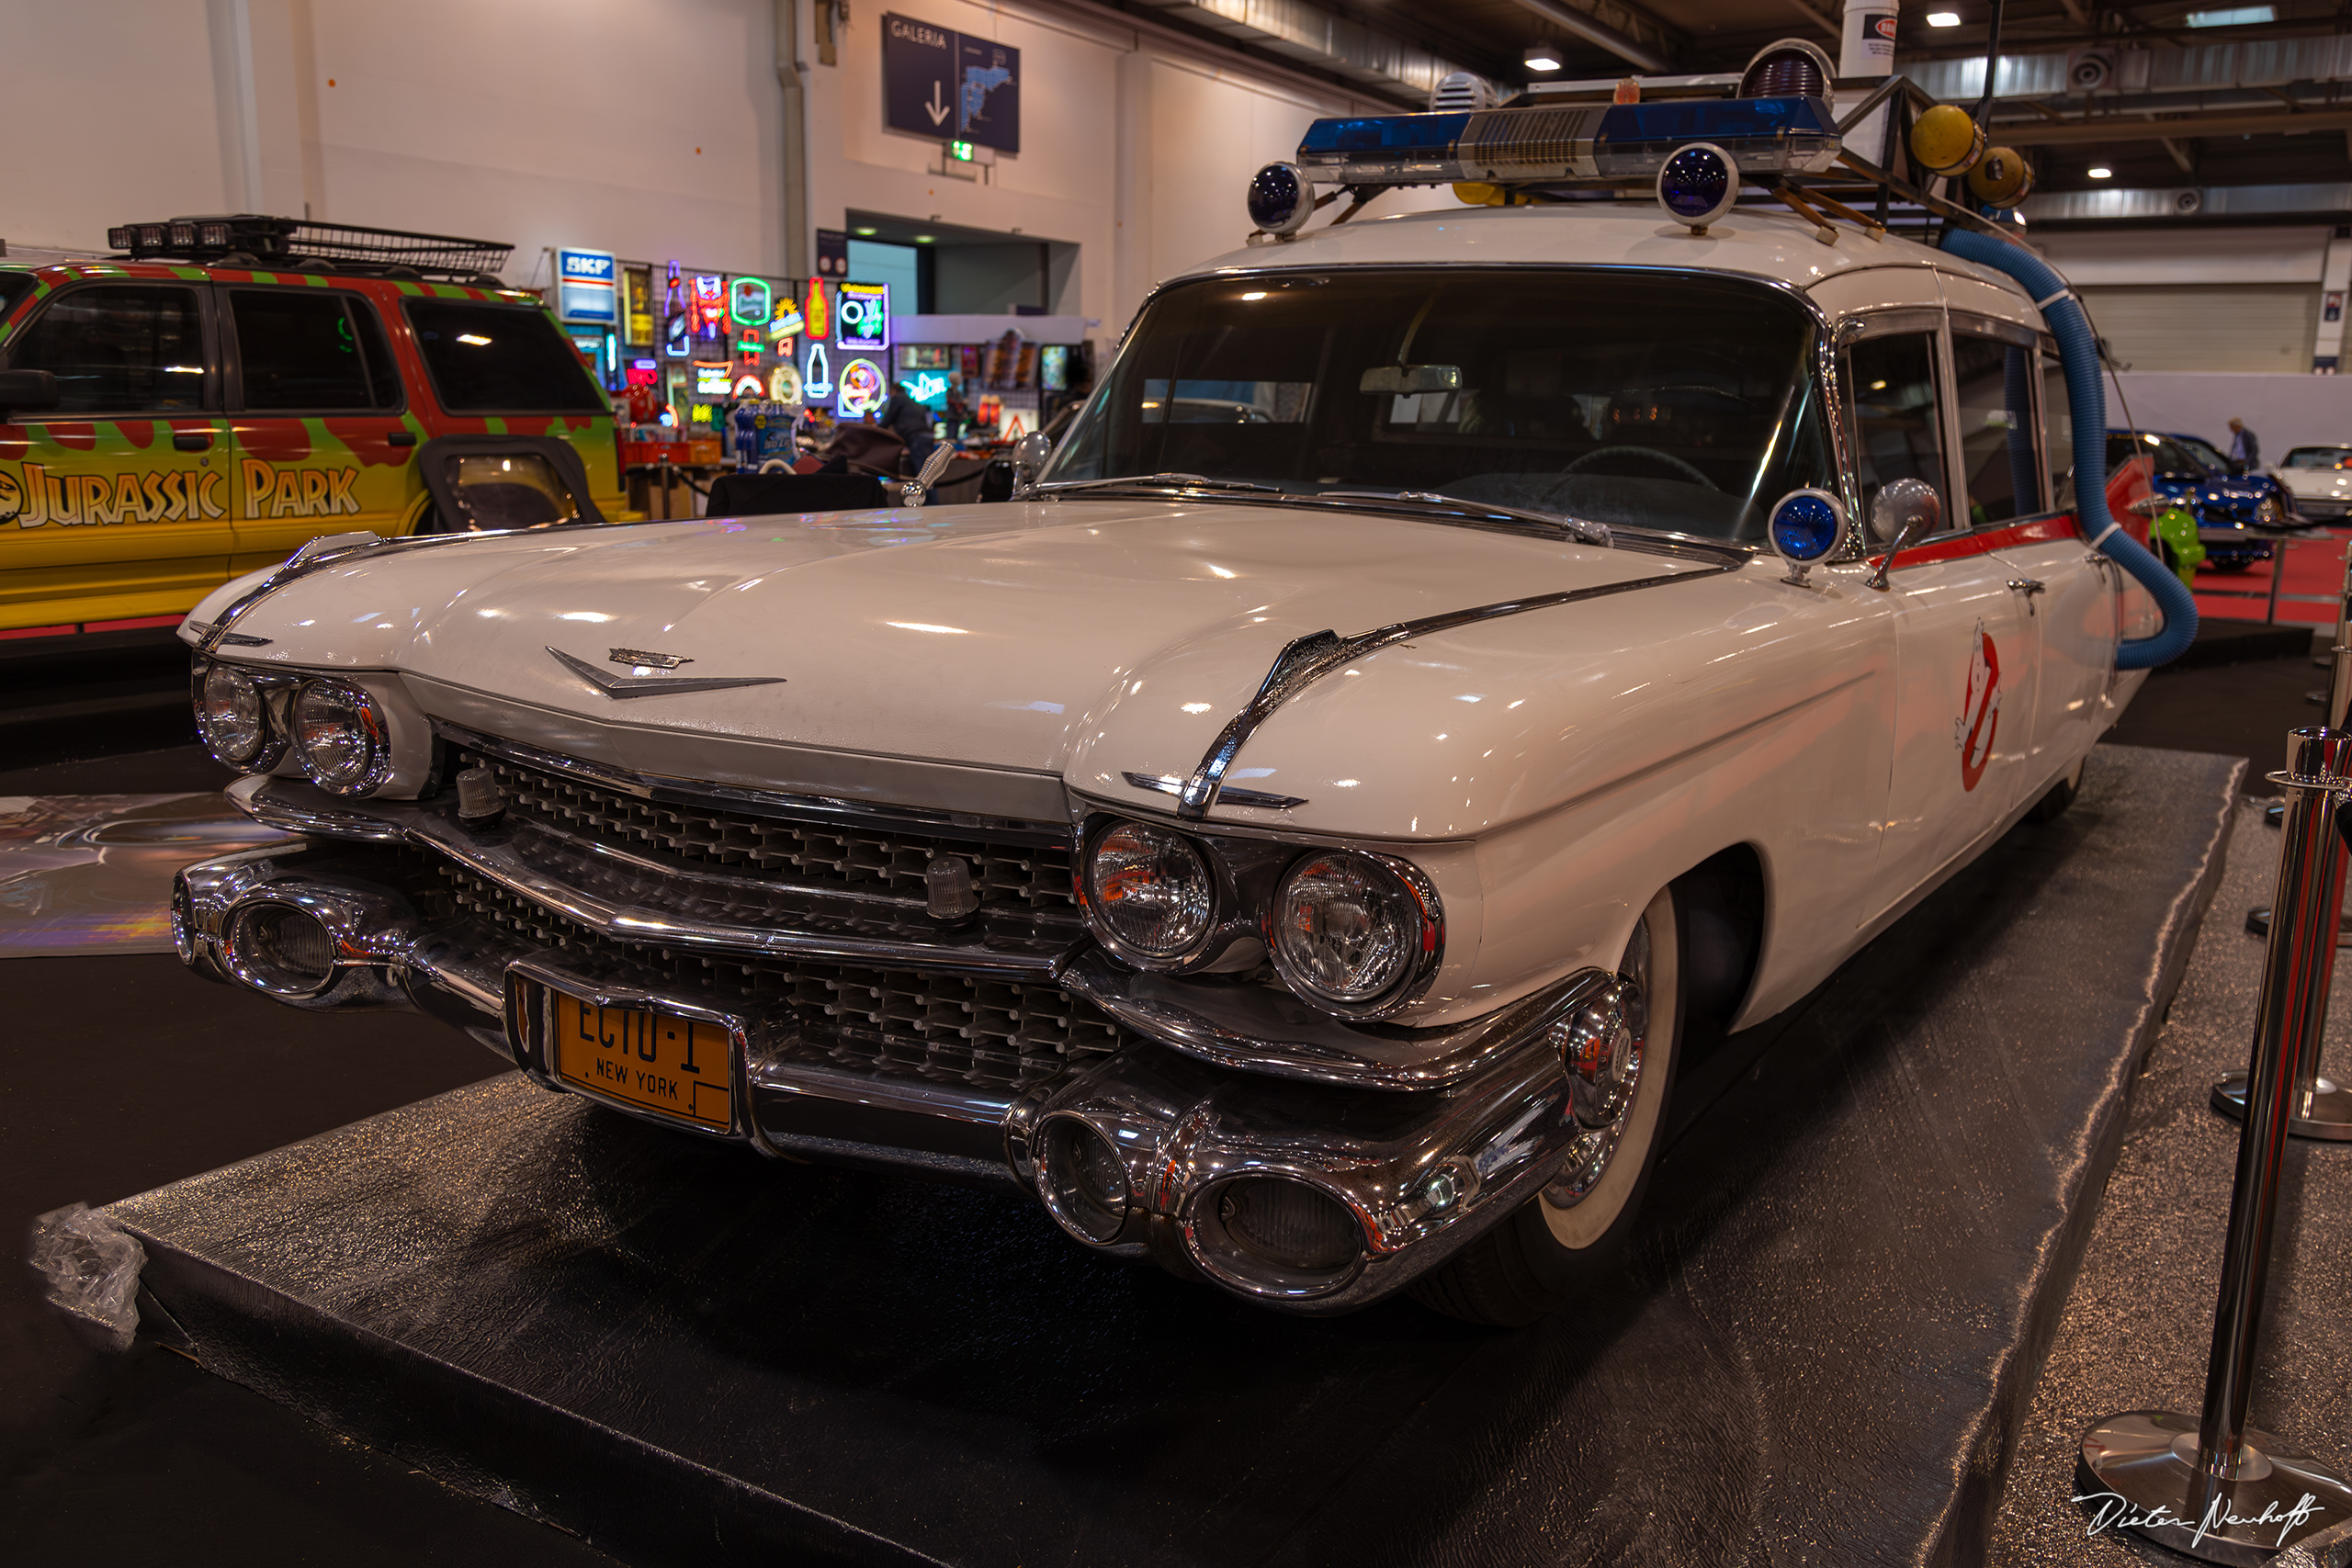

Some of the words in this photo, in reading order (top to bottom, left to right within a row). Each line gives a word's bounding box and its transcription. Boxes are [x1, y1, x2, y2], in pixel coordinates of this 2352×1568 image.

[890, 19, 947, 50] GALERIA
[566, 256, 611, 275] SKF
[596, 1057, 628, 1085] NEW
[636, 1069, 678, 1100] YORK
